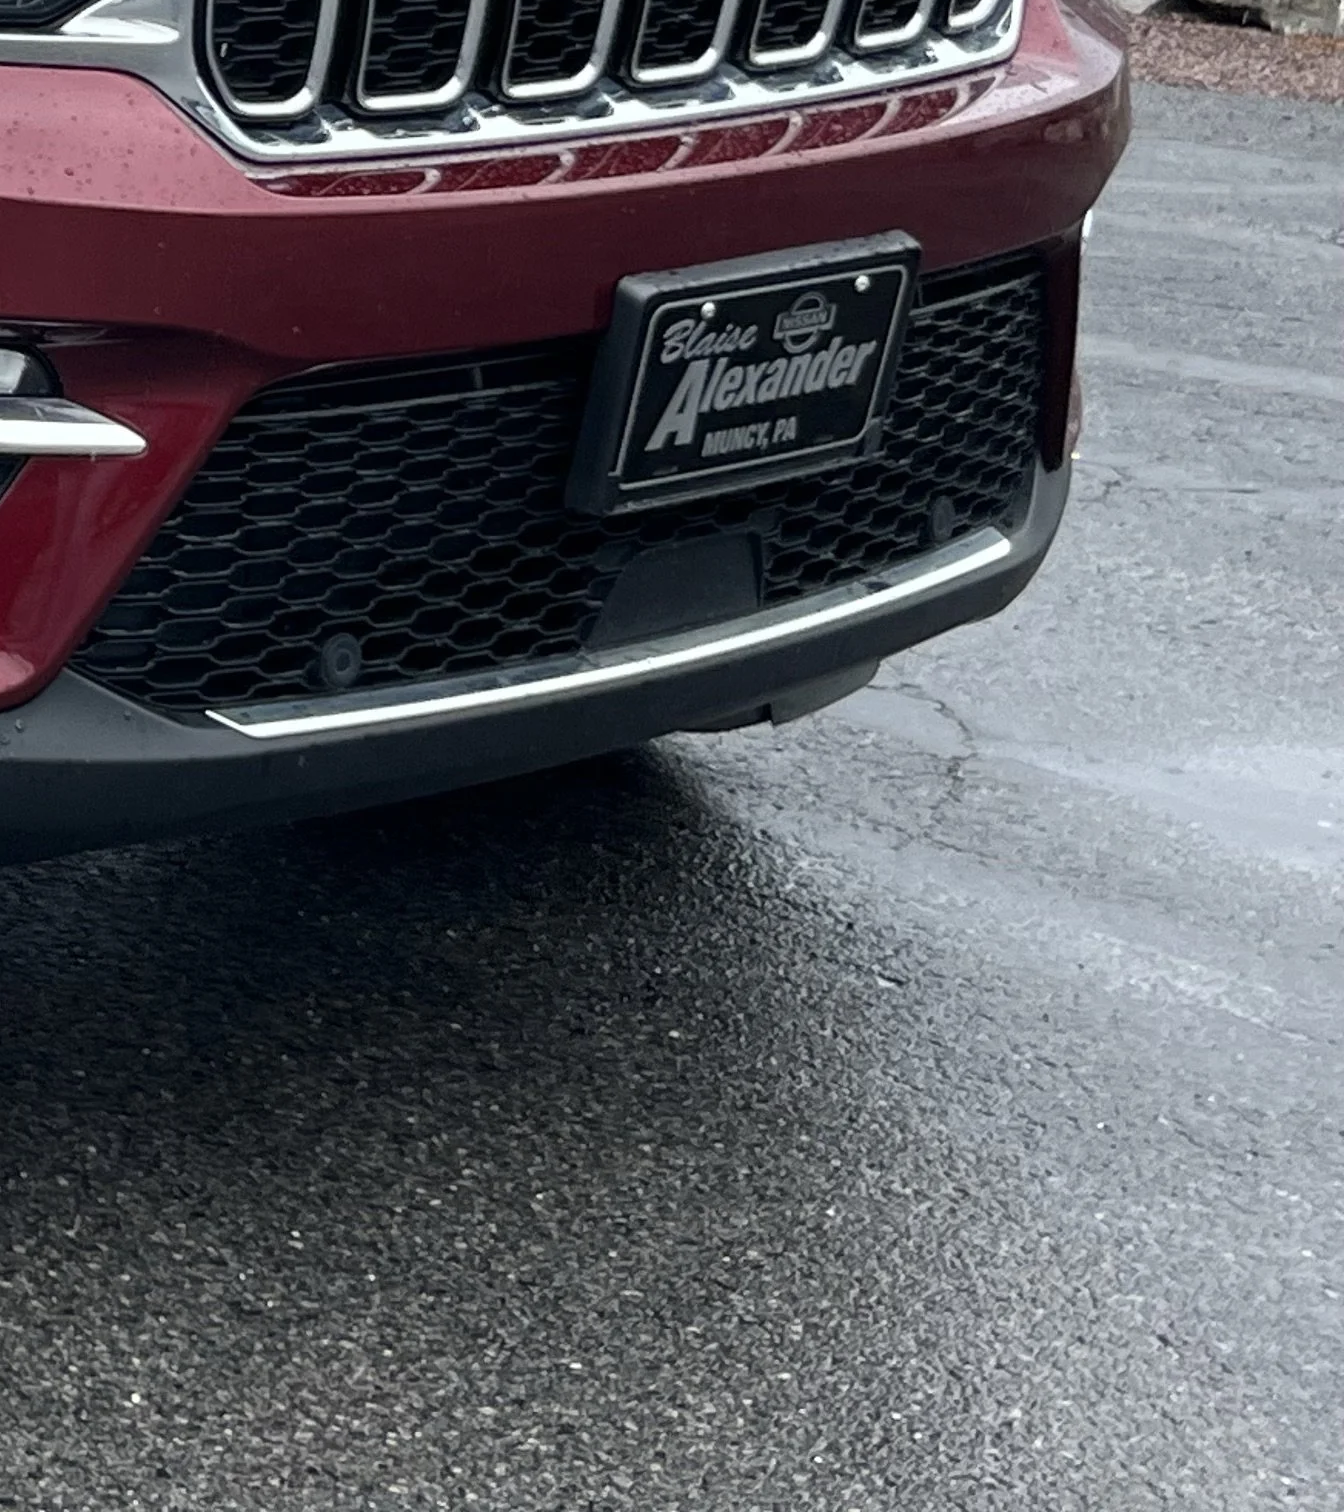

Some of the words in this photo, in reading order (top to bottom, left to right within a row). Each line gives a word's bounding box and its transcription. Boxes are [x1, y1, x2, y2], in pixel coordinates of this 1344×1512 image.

[660, 318, 759, 364] Blaise
[644, 336, 878, 452] Alexander
[701, 424, 770, 458] MUNCY,
[772, 416, 797, 443] PA
